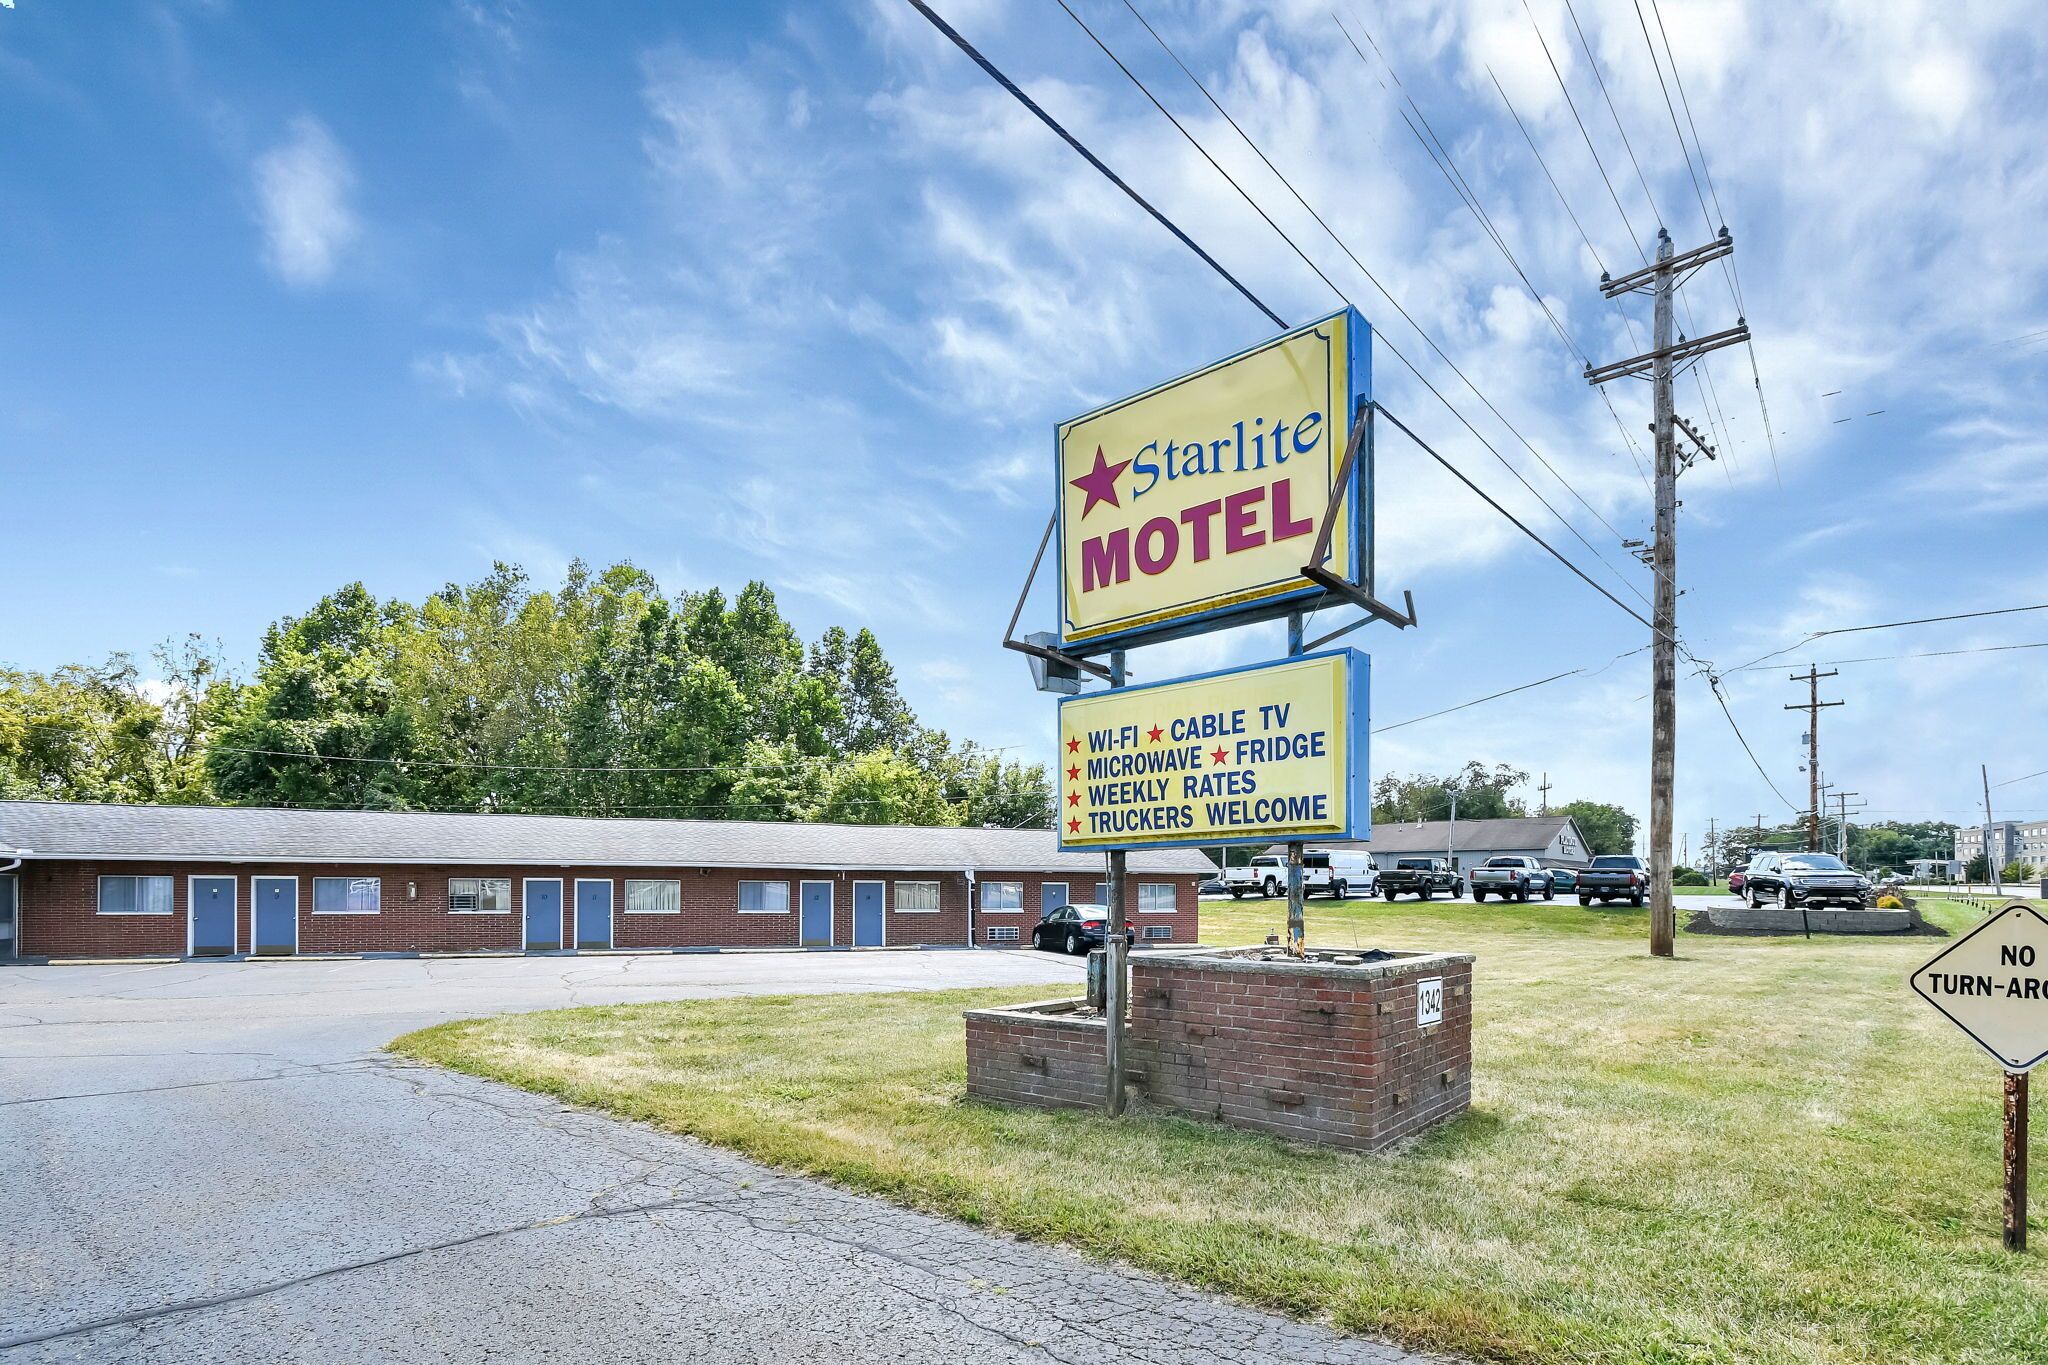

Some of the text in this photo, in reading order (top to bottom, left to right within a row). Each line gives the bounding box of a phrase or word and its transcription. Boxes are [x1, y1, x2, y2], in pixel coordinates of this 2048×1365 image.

[1132, 411, 1322, 502] Starlite
[1081, 478, 1313, 593] MOTEL
[1088, 725, 1138, 753] WI-FI
[1170, 709, 1246, 742] CABLE
[1259, 702, 1291, 730] TV
[1087, 731, 1326, 780] MICROWAVE FRIDGE
[1088, 769, 1257, 806] WEEKLY RATES
[1088, 794, 1327, 834] TRUCKERS WELCOME
[2001, 945, 2036, 967] NO
[1420, 988, 1441, 1016] 1342
